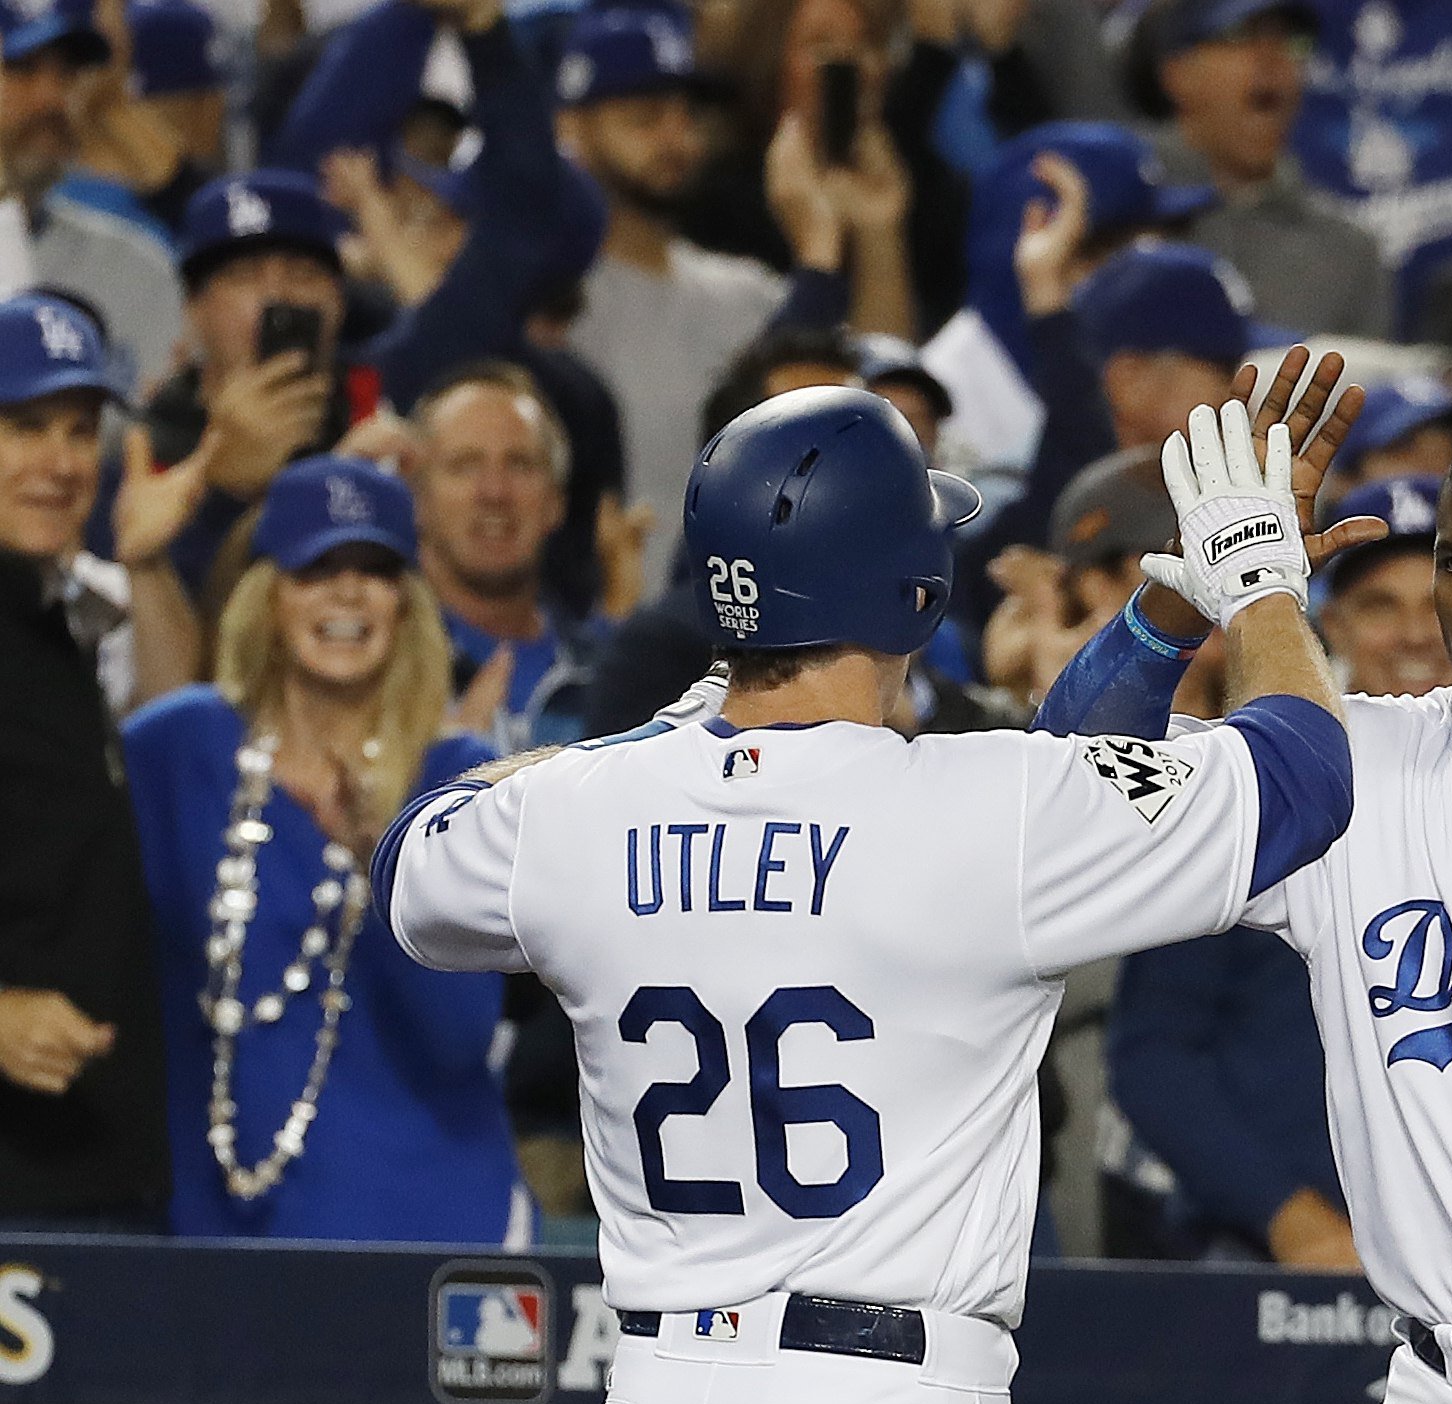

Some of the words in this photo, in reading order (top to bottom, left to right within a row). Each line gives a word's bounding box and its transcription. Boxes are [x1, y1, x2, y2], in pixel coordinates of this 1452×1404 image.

[706, 555, 759, 605] 26
[714, 602, 761, 620] WORLD
[720, 616, 759, 633] SERIES
[1157, 752, 1183, 788] 2017
[627, 821, 851, 917] UTLEY
[617, 984, 885, 1221] 26
[1257, 1291, 1363, 1344] Bank
